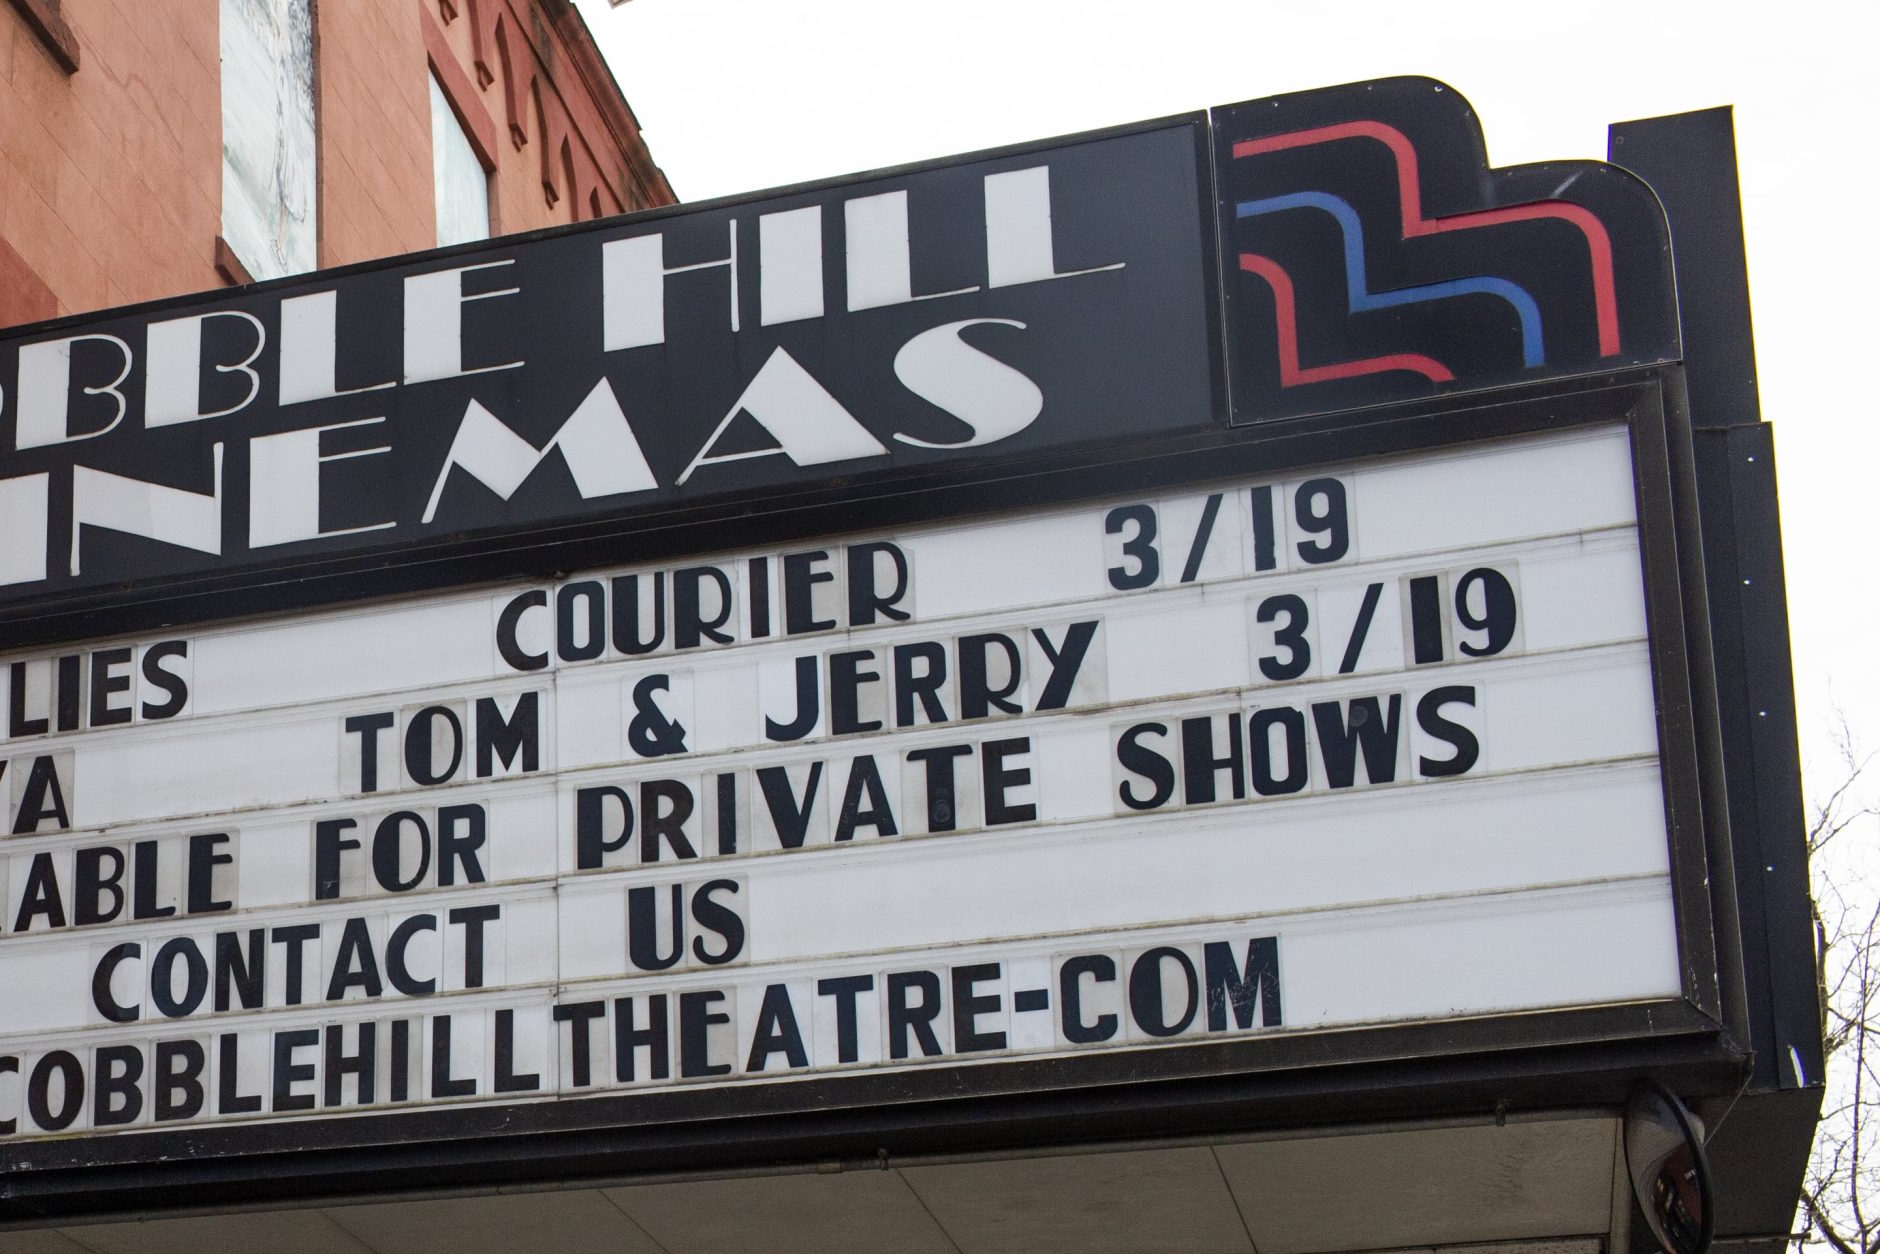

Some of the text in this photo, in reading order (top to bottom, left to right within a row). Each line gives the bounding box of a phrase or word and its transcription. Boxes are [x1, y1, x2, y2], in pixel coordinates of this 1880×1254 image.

[603, 166, 1125, 351] HILL
[10, 640, 187, 737] LIES
[497, 542, 910, 671] COURIER
[1106, 478, 1349, 590] 3/19
[346, 692, 538, 793] TOM
[628, 674, 688, 757] &
[766, 621, 1105, 741] JERRY
[1257, 568, 1516, 681] 3/19
[316, 804, 485, 900] FOR
[577, 737, 1036, 870] PRIVATE
[1117, 686, 1479, 810] SHOWS
[92, 879, 744, 1023] CONTACT US
